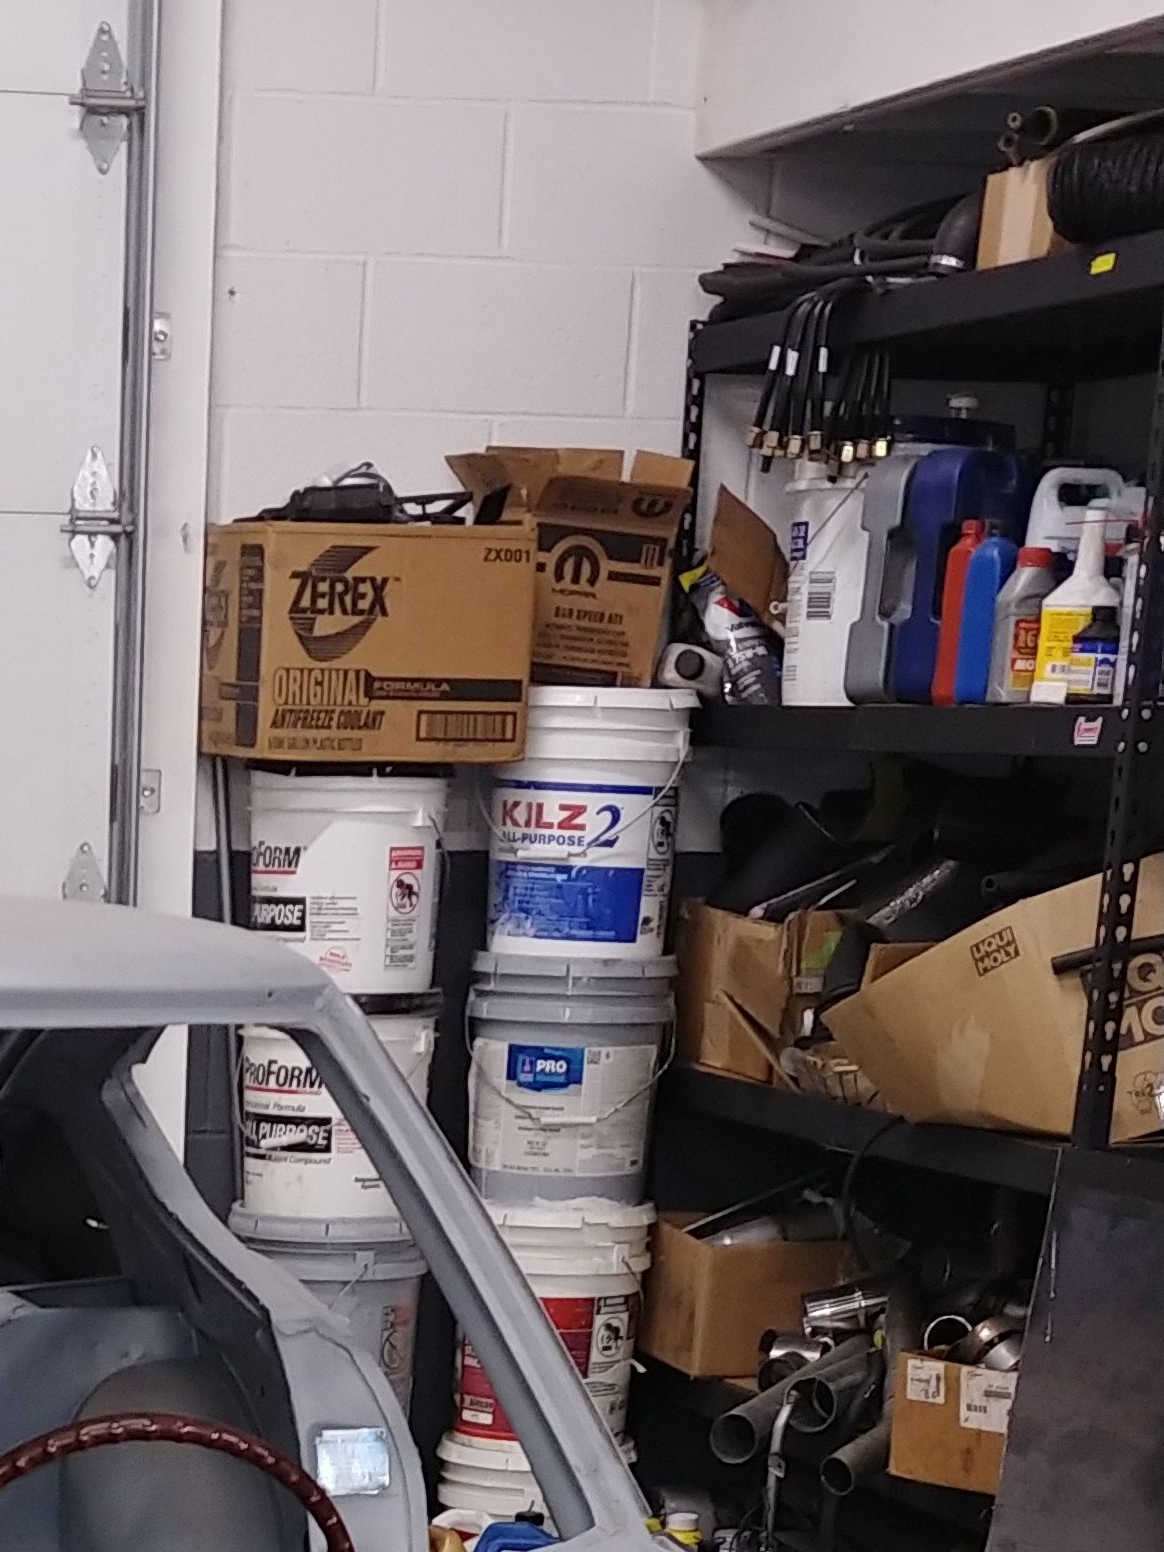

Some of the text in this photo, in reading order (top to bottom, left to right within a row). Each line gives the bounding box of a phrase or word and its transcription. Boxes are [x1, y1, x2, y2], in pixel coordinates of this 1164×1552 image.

[484, 547, 531, 563] ZX001
[288, 570, 389, 617] ZEREX
[273, 667, 451, 706] ORIGINAL FORMULA
[270, 708, 386, 731] ANTIFREEZE COOLANT
[501, 800, 622, 849] KILZ 2
[972, 927, 1013, 959] LIQUI
[977, 943, 1018, 974] MOLY
[536, 1060, 567, 1073] PRO
